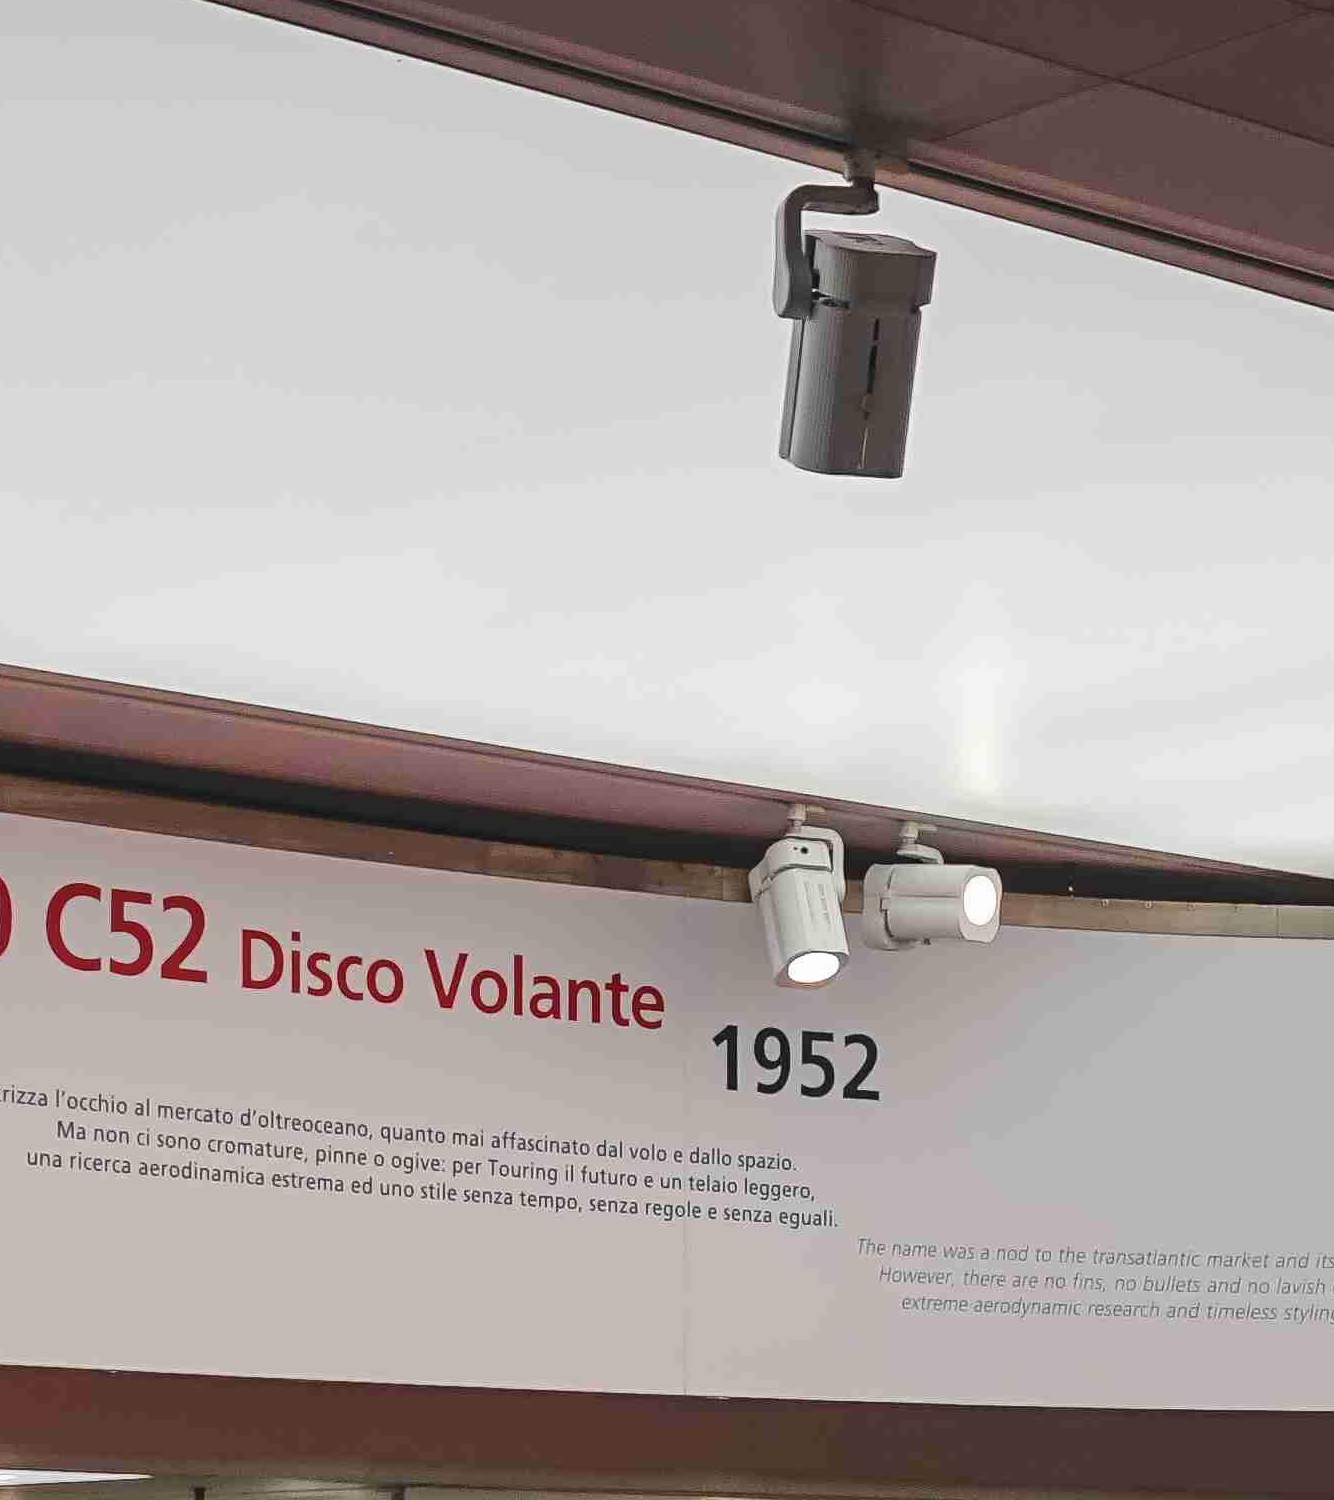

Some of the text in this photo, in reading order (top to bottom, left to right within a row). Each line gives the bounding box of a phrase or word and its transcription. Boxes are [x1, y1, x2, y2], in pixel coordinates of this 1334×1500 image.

[46, 882, 208, 982] C52
[240, 929, 404, 1004] Disco
[426, 948, 665, 1029] Volante
[712, 1024, 880, 1101] 1952
[56, 1120, 87, 1140] Ma
[93, 1127, 131, 1144] non
[136, 1127, 151, 1146] ci
[156, 1133, 202, 1151] sono
[207, 1138, 309, 1166] cromature,
[315, 1145, 368, 1170] pinne
[373, 1154, 385, 1169] o
[390, 1152, 446, 1176] ogive:
[451, 1160, 483, 1180] per
[487, 1159, 559, 1188] Touring
[564, 1163, 575, 1184] il
[579, 1164, 638, 1188] futuro
[659, 1175, 683, 1191] un
[687, 1174, 739, 1194] telaio
[743, 1177, 817, 1203] leggero,
[133, 1098, 151, 1118] al
[156, 1104, 234, 1126] mercato
[379, 1125, 446, 1145] quanto
[451, 1129, 485, 1148] mai
[490, 1131, 591, 1157] affascinato
[595, 1139, 624, 1160] dal
[629, 1143, 668, 1163] volo
[672, 1149, 684, 1164] e
[688, 1146, 733, 1167] dallo
[736, 1152, 799, 1174] spazio.
[26, 1148, 838, 1230] una ricerca aerodinamica estrema ed uno stile senza tempo, senza regole e senza eguali.
[857, 1237, 886, 1256] The
[891, 1242, 938, 1258] name
[943, 1245, 976, 1260] was
[979, 1246, 990, 1260] a
[996, 1244, 1029, 1262] nod
[1036, 1247, 1052, 1263] to
[1059, 1246, 1087, 1264] the
[1092, 1249, 1203, 1267] transatlantic
[1206, 1250, 1269, 1268] market
[1274, 1251, 1310, 1269] and
[963, 1268, 1007, 1288] there
[1012, 1274, 1039, 1289] are
[1044, 1275, 1067, 1290] no
[1114, 1278, 1137, 1293] no
[1142, 1274, 1202, 1293] bullets
[1206, 1275, 1242, 1294] and
[1247, 1279, 1271, 1294] no
[1275, 1275, 1326, 1294] lavish
[901, 1295, 968, 1313] extreme
[972, 1296, 1083, 1320] aerodynamic
[1087, 1301, 1160, 1317] research
[1165, 1301, 1202, 1318] and
[1206, 1301, 1278, 1319] timeless
